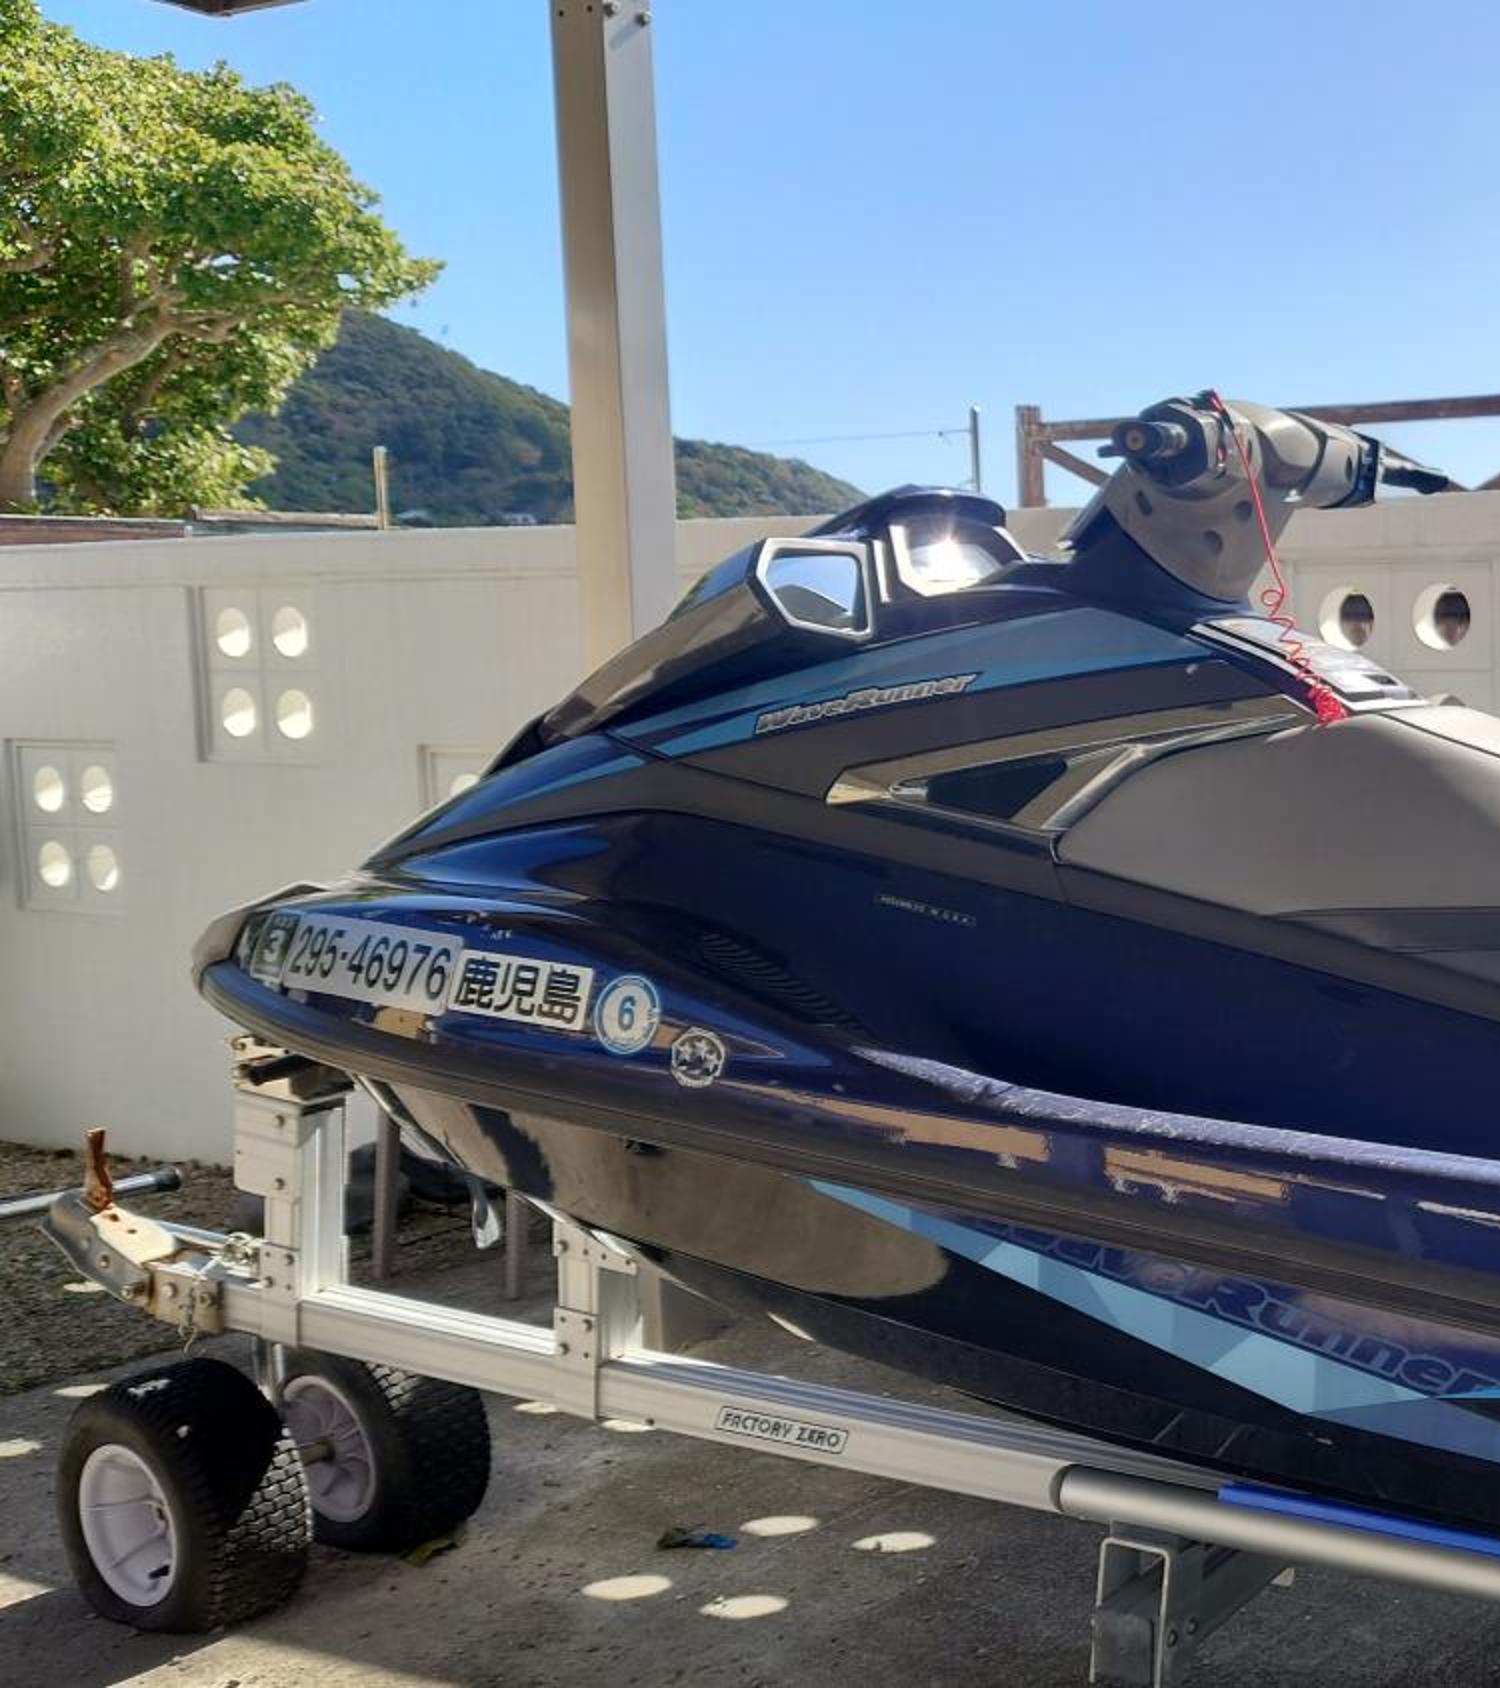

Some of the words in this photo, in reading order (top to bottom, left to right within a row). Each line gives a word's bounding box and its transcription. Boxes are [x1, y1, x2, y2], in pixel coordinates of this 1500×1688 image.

[263, 929, 286, 962] 3
[288, 925, 450, 1001] 295-46976
[454, 956, 581, 1024] 鹿児島
[618, 996, 636, 1031] 6
[722, 1413, 791, 1438] FACTORY
[797, 1426, 841, 1448] ZERO
